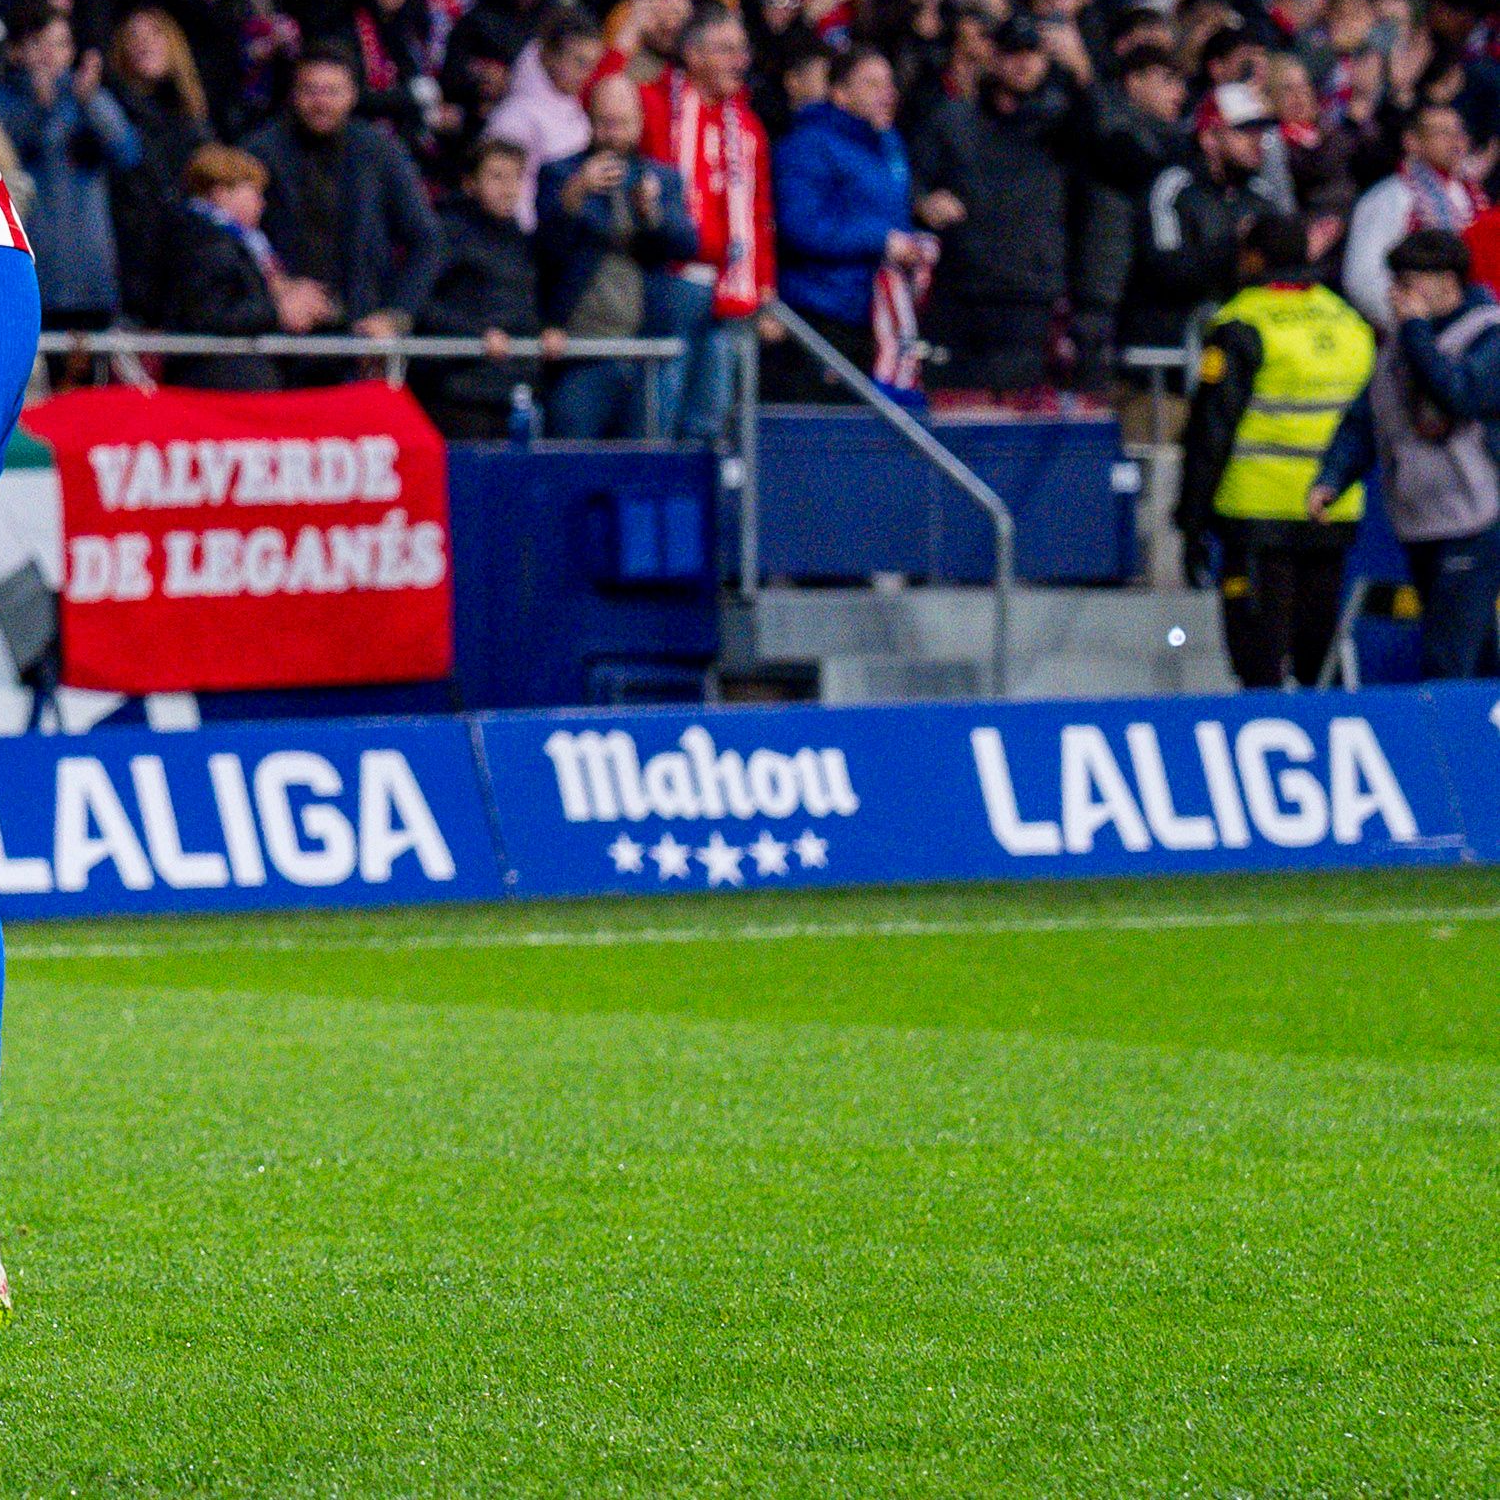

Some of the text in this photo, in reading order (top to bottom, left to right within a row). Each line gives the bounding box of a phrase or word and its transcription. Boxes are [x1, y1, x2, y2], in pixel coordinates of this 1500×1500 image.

[88, 435, 402, 511] VALVERDE
[64, 509, 446, 604] DE LEGANÉS
[543, 726, 860, 823] Mahou
[970, 715, 1418, 856] LALIGA
